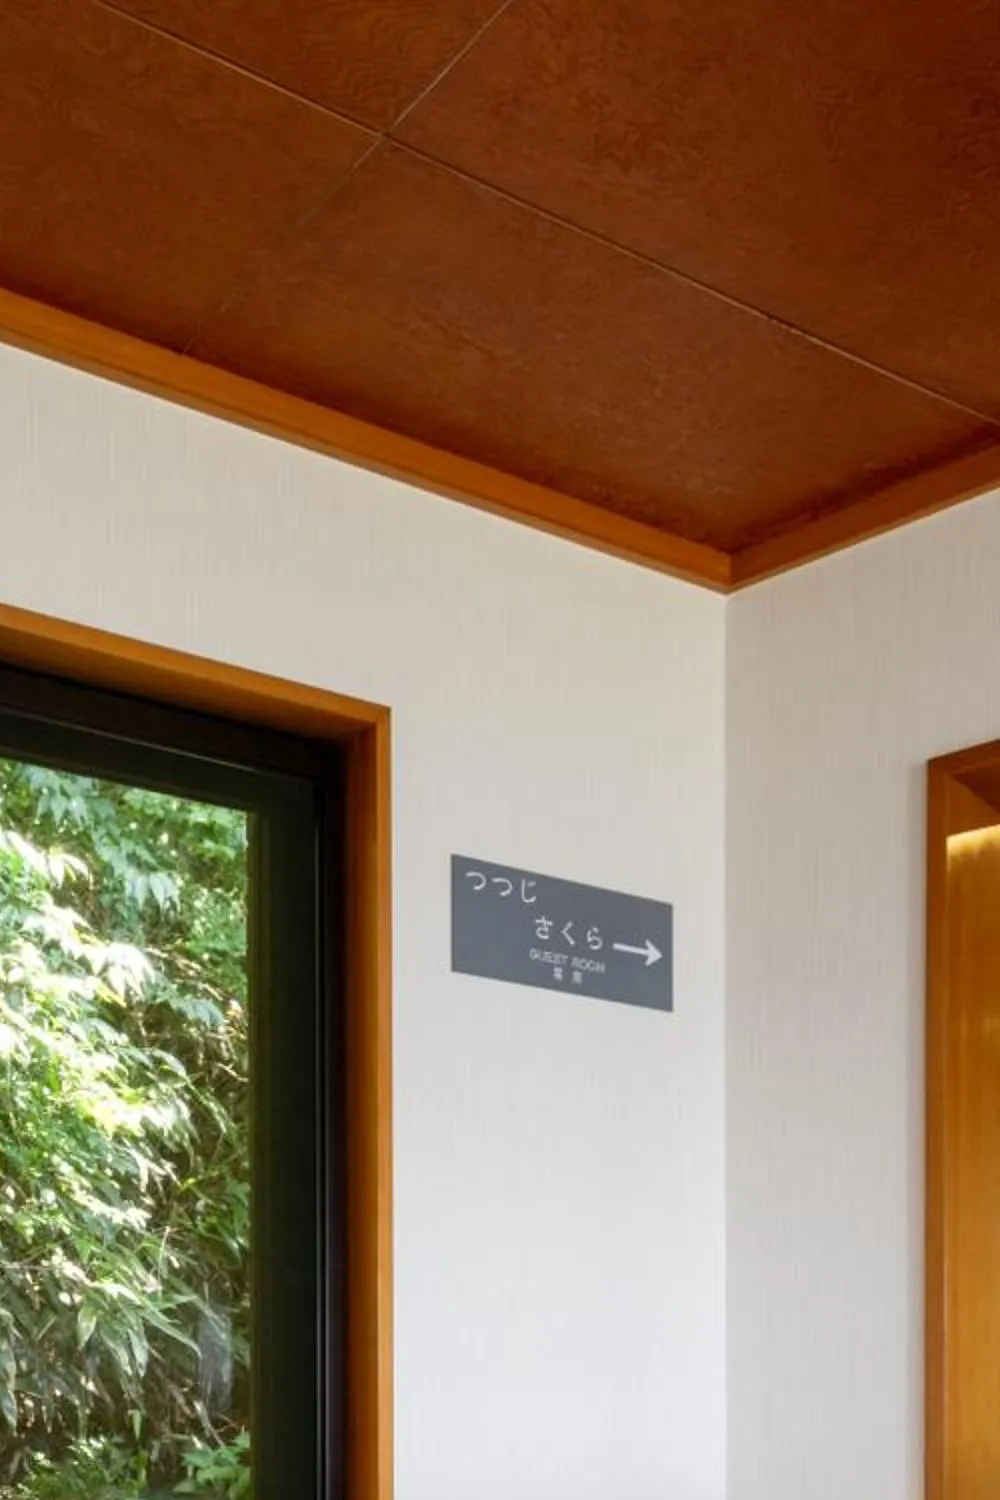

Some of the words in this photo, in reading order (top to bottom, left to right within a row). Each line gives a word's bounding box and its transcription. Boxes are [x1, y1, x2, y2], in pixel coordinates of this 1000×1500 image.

[465, 871, 538, 904] つつじ
[534, 915, 603, 951] さくら
